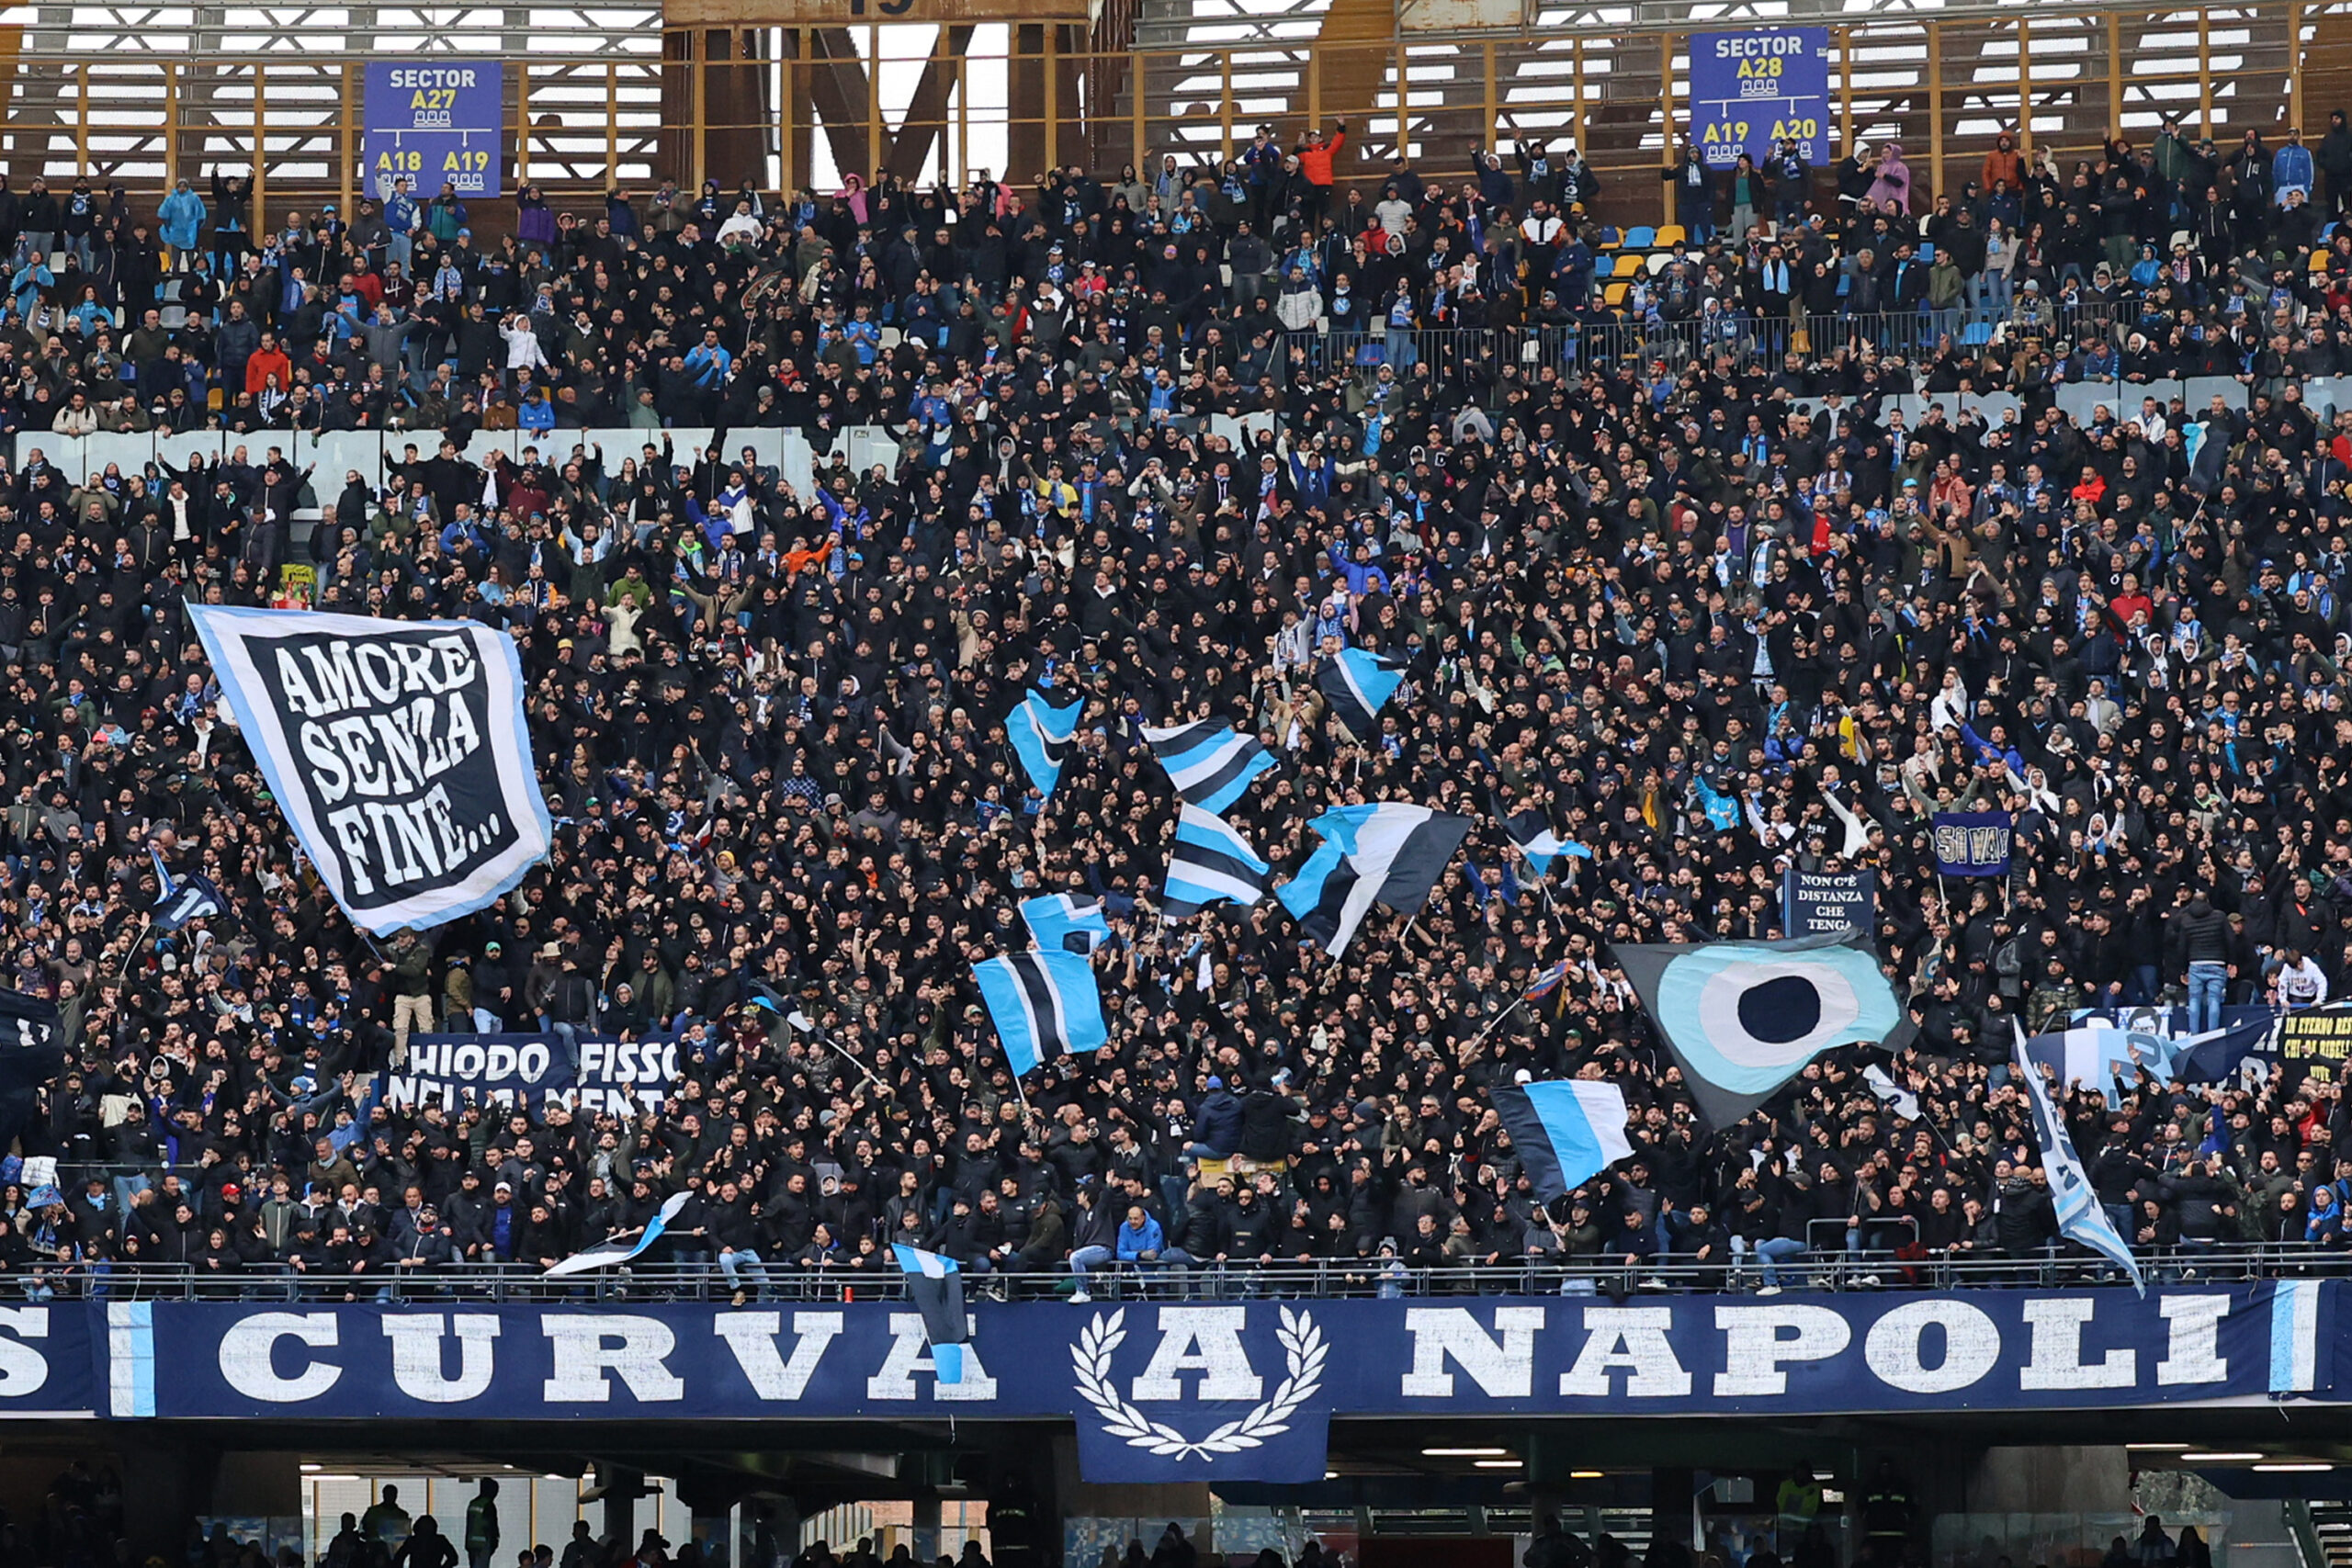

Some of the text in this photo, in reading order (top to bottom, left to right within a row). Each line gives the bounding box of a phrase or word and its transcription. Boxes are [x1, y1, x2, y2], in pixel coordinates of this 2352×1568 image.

[1715, 36, 1803, 58] SECTOR
[390, 69, 476, 88] SECTOR
[1736, 57, 1783, 79] A28
[410, 89, 457, 109] A27
[1702, 121, 1749, 144] A19
[1770, 118, 1816, 141] A20
[379, 152, 422, 172] A18
[442, 152, 489, 172] A19
[275, 635, 476, 717] AMORE
[300, 692, 481, 806] SENZA
[327, 782, 501, 896] FINE...
[1801, 874, 1832, 887] NON
[1797, 889, 1864, 902] DISTANZA
[1815, 906, 1845, 917] CHE
[2298, 1017, 2334, 1035] ETERNO
[218, 1294, 2232, 1403] CURVA A NAPOLI
